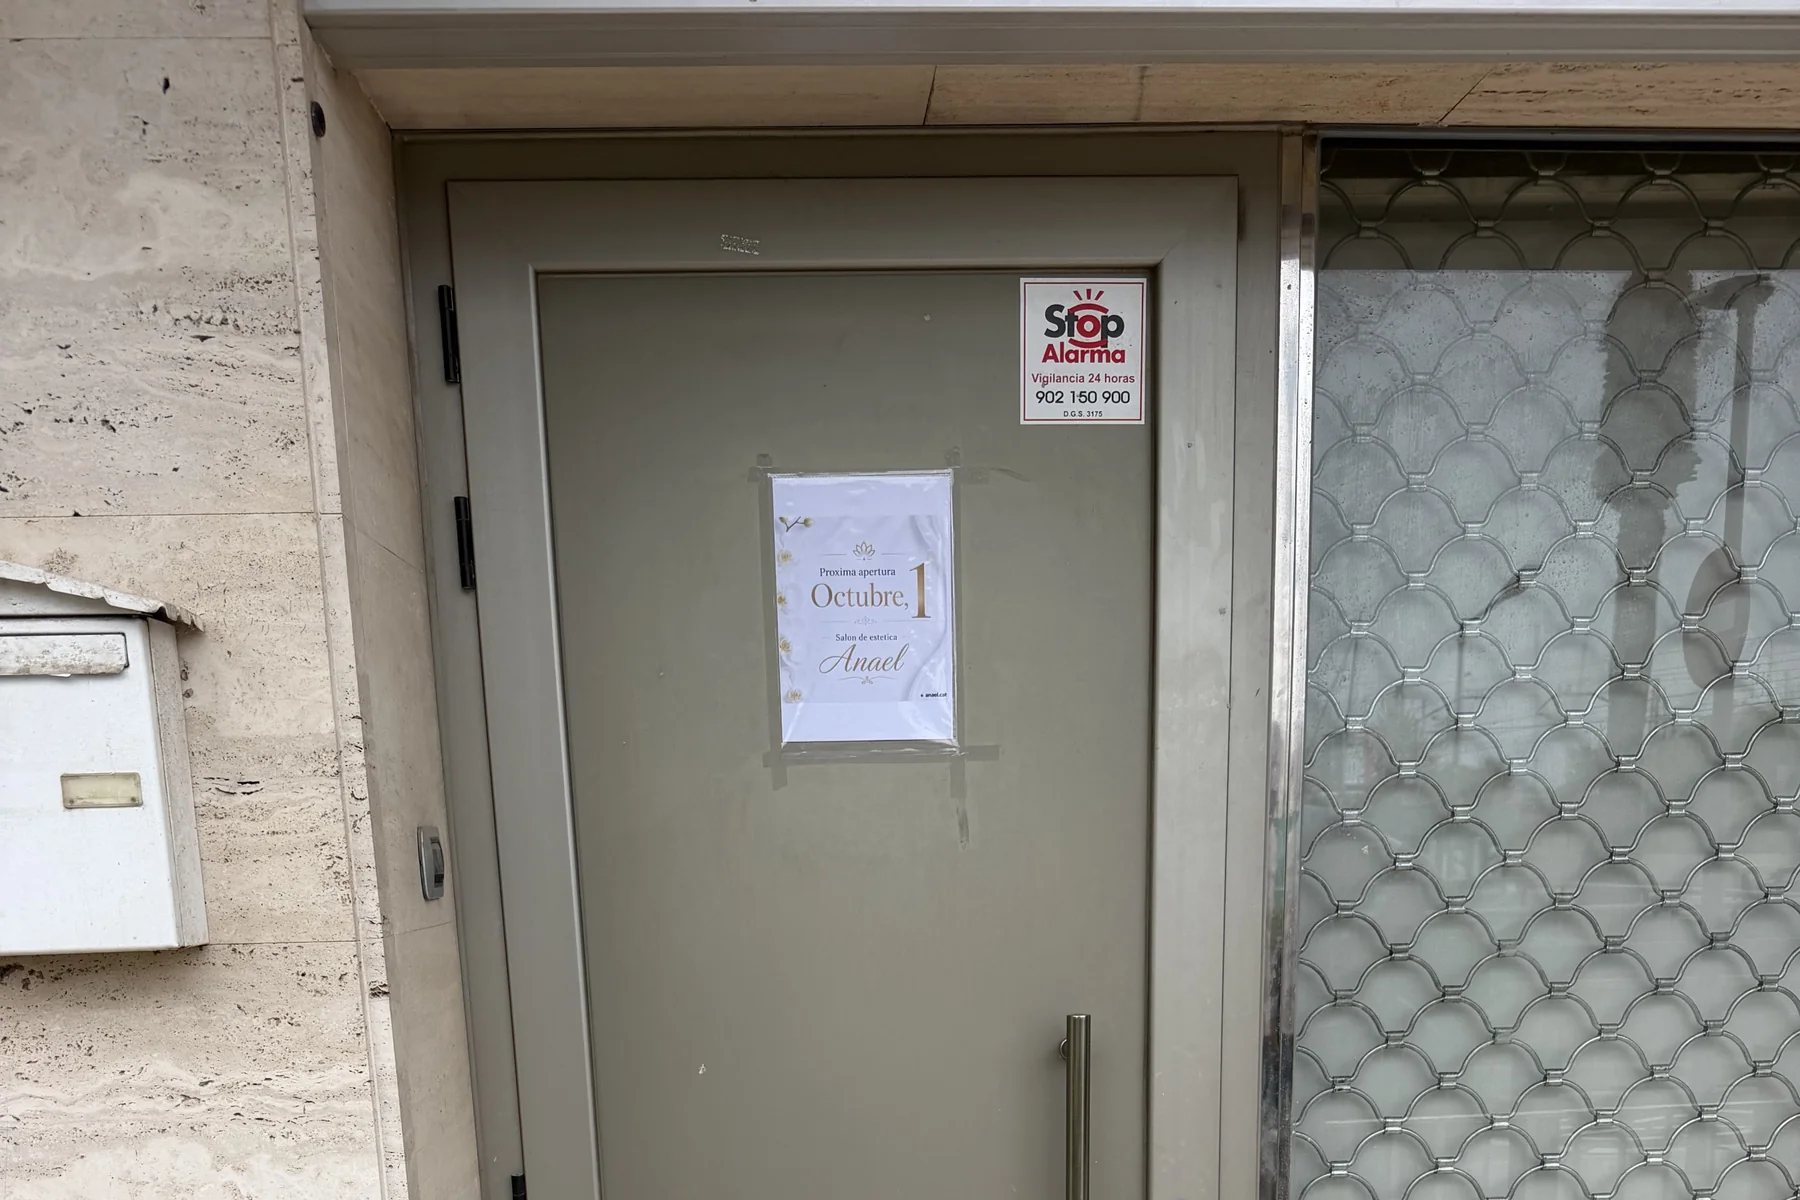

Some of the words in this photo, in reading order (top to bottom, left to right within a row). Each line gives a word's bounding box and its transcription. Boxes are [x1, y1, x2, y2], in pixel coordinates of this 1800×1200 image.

[1044, 303, 1125, 348] Stop
[1041, 341, 1125, 363] Alarma
[1031, 373, 1085, 386] Vigilancia
[1088, 373, 1101, 383] 24
[1104, 373, 1135, 383] horas
[1035, 390, 1064, 404] 902
[1070, 390, 1097, 404] 150
[1102, 390, 1130, 404] 900
[819, 567, 856, 577] Proxima
[858, 568, 896, 579] apertura
[811, 582, 909, 610] Octubre,
[909, 562, 932, 619] 1
[835, 633, 857, 641] Salon
[858, 633, 868, 641] de
[869, 633, 898, 641] estetica
[818, 643, 910, 674] Anael
